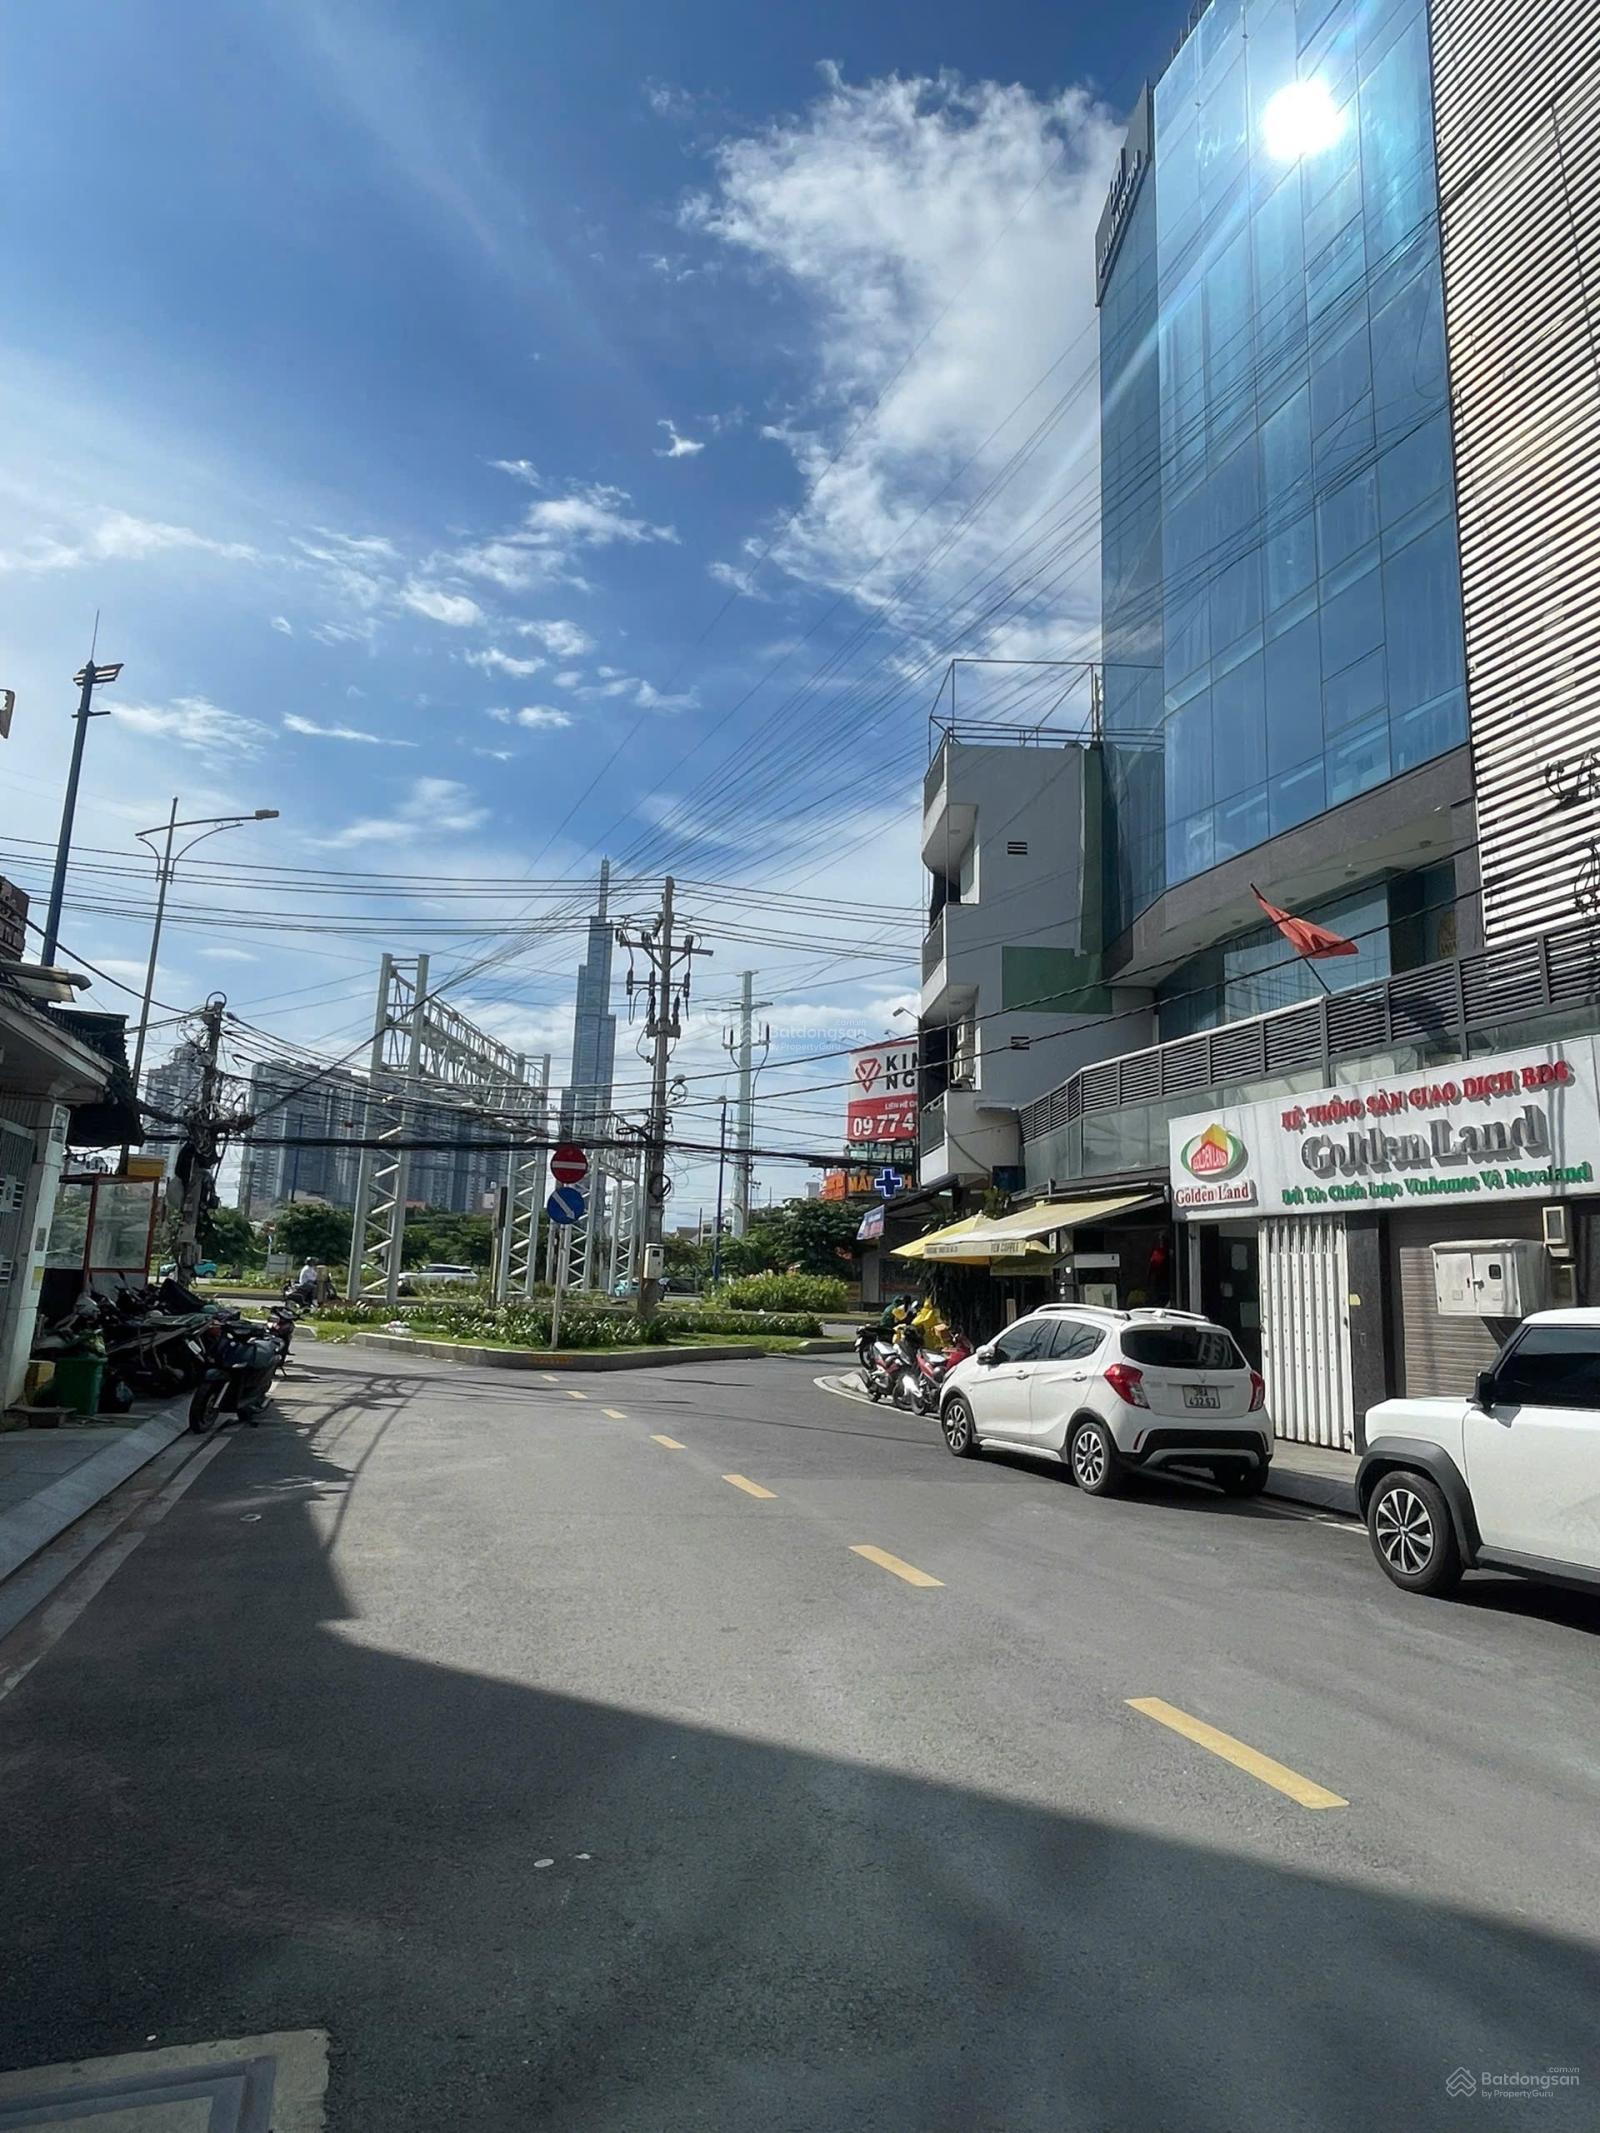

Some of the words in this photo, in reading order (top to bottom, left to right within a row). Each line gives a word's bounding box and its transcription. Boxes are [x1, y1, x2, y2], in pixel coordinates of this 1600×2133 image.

[1366, 1089, 1406, 1115] SÀN
[1408, 1081, 1459, 1108] GIAO
[1301, 1127, 1431, 1177] Golden
[1427, 1105, 1550, 1163] Land
[1175, 1187, 1215, 1205] Golden
[1218, 1182, 1250, 1201] Land
[1404, 1175, 1481, 1196] Vinhomes
